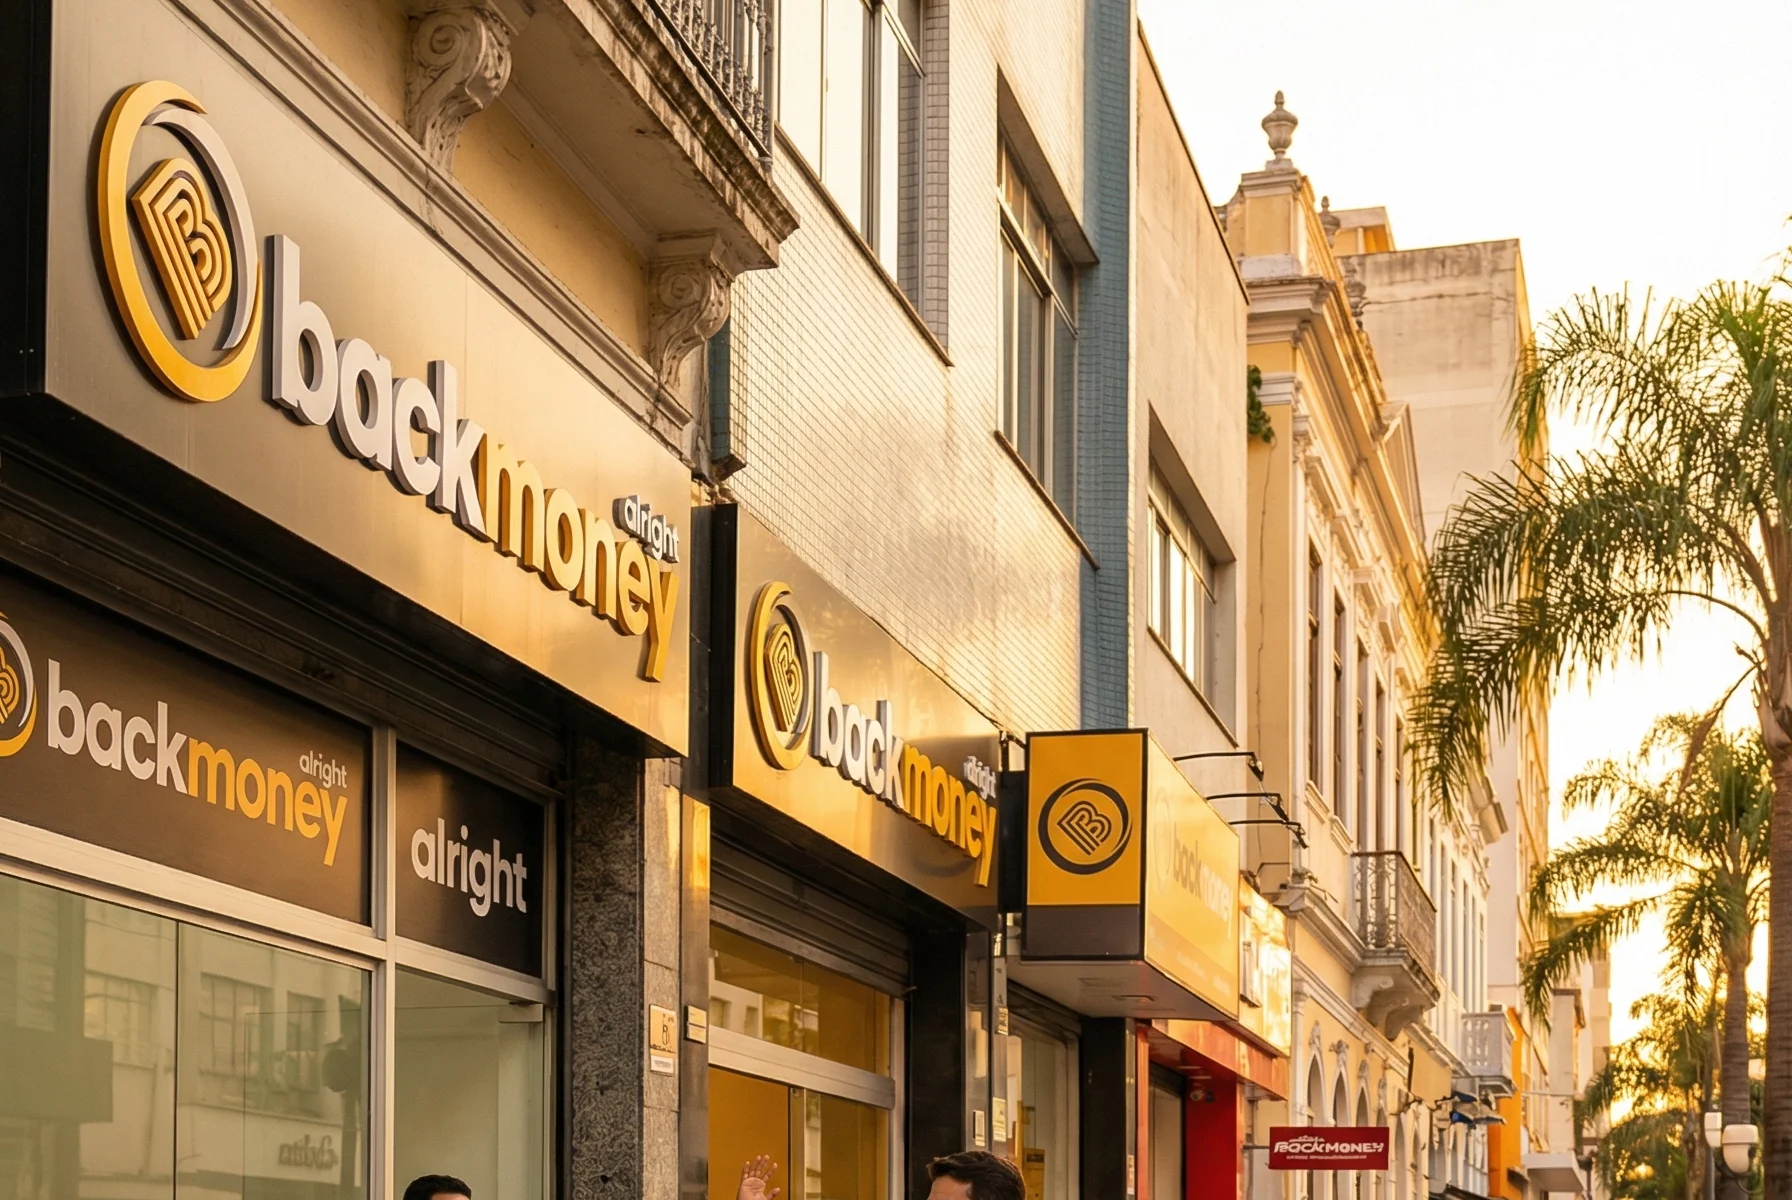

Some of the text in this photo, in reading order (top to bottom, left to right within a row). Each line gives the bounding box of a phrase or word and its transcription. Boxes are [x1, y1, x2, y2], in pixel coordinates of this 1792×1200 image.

[267, 234, 679, 682] backmoney
[613, 494, 680, 564] alright
[47, 658, 348, 867] backmoney
[299, 750, 348, 790] alright
[811, 650, 997, 888] backmoney
[410, 817, 528, 918] alright
